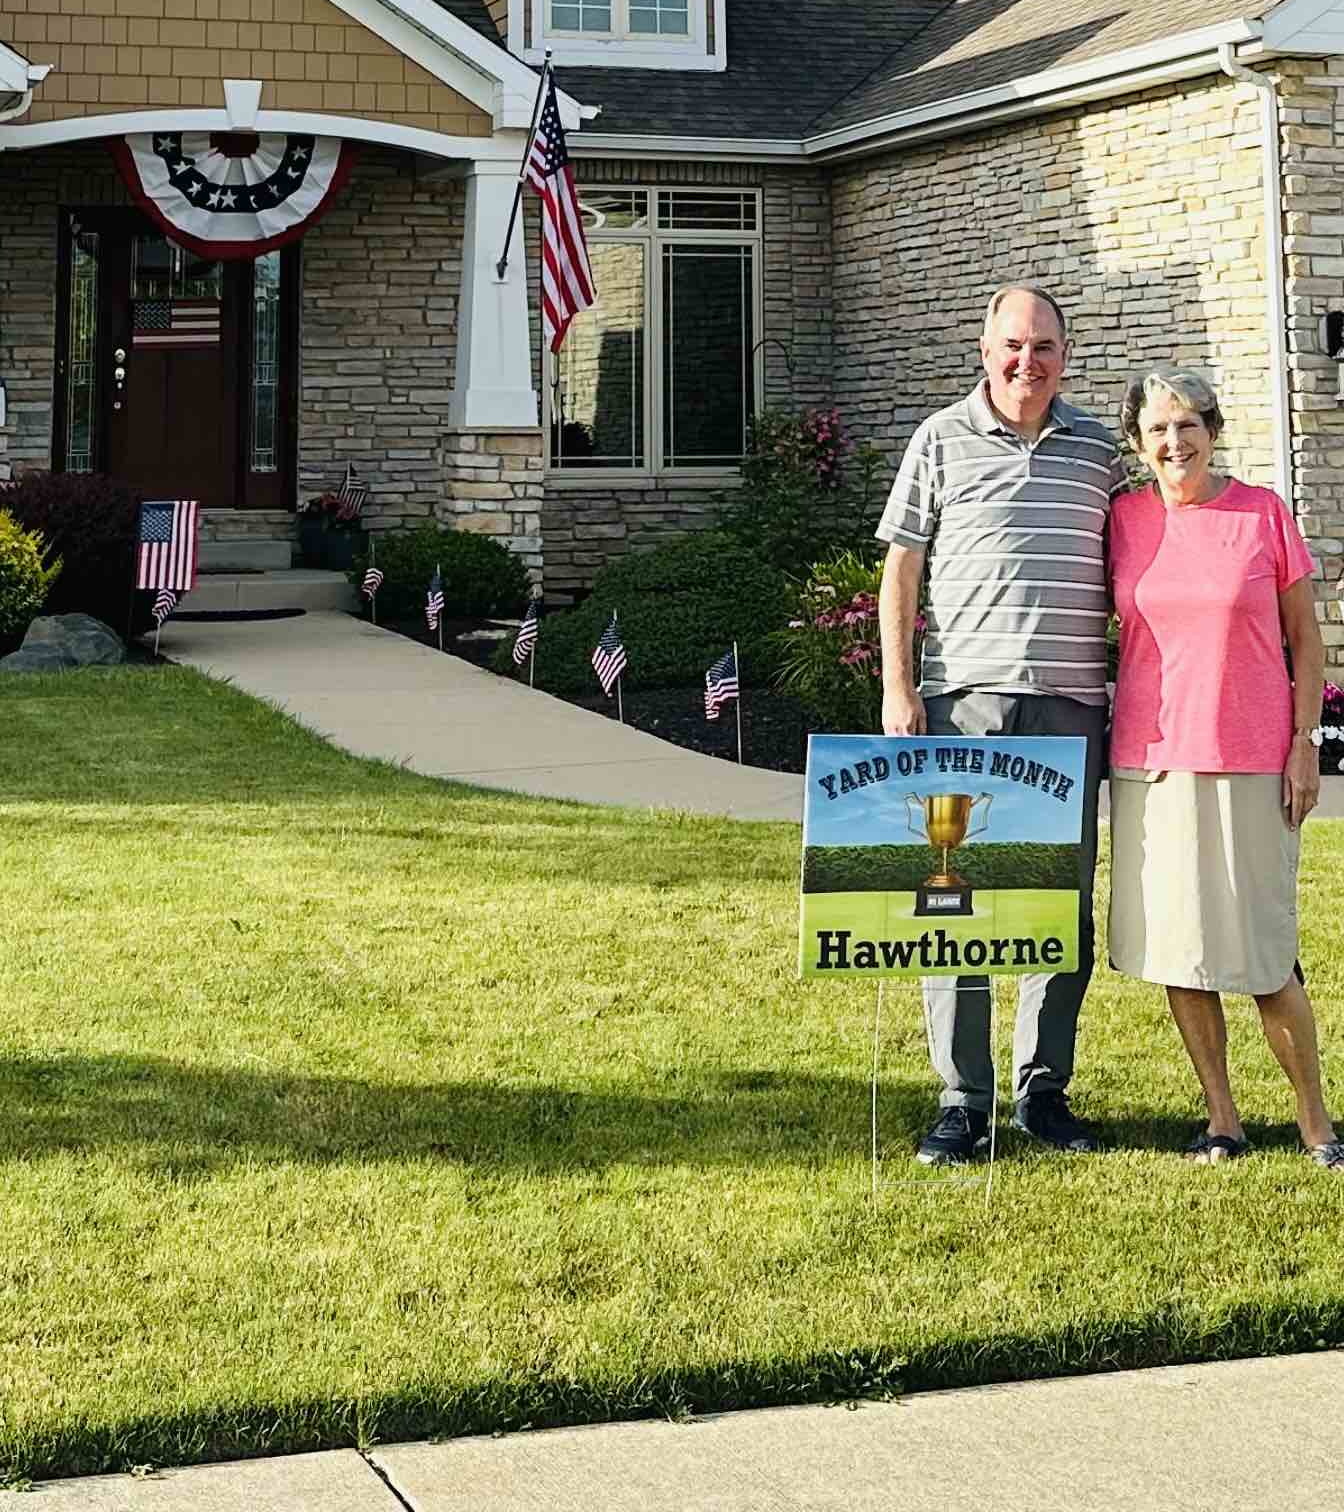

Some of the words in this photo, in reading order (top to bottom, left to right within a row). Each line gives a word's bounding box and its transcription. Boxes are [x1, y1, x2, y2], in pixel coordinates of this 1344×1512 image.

[818, 755, 890, 800] YARD
[896, 748, 929, 777] OF
[935, 747, 983, 774] THE
[991, 751, 1075, 802] MONTH
[816, 929, 1064, 970] Hawthorne
